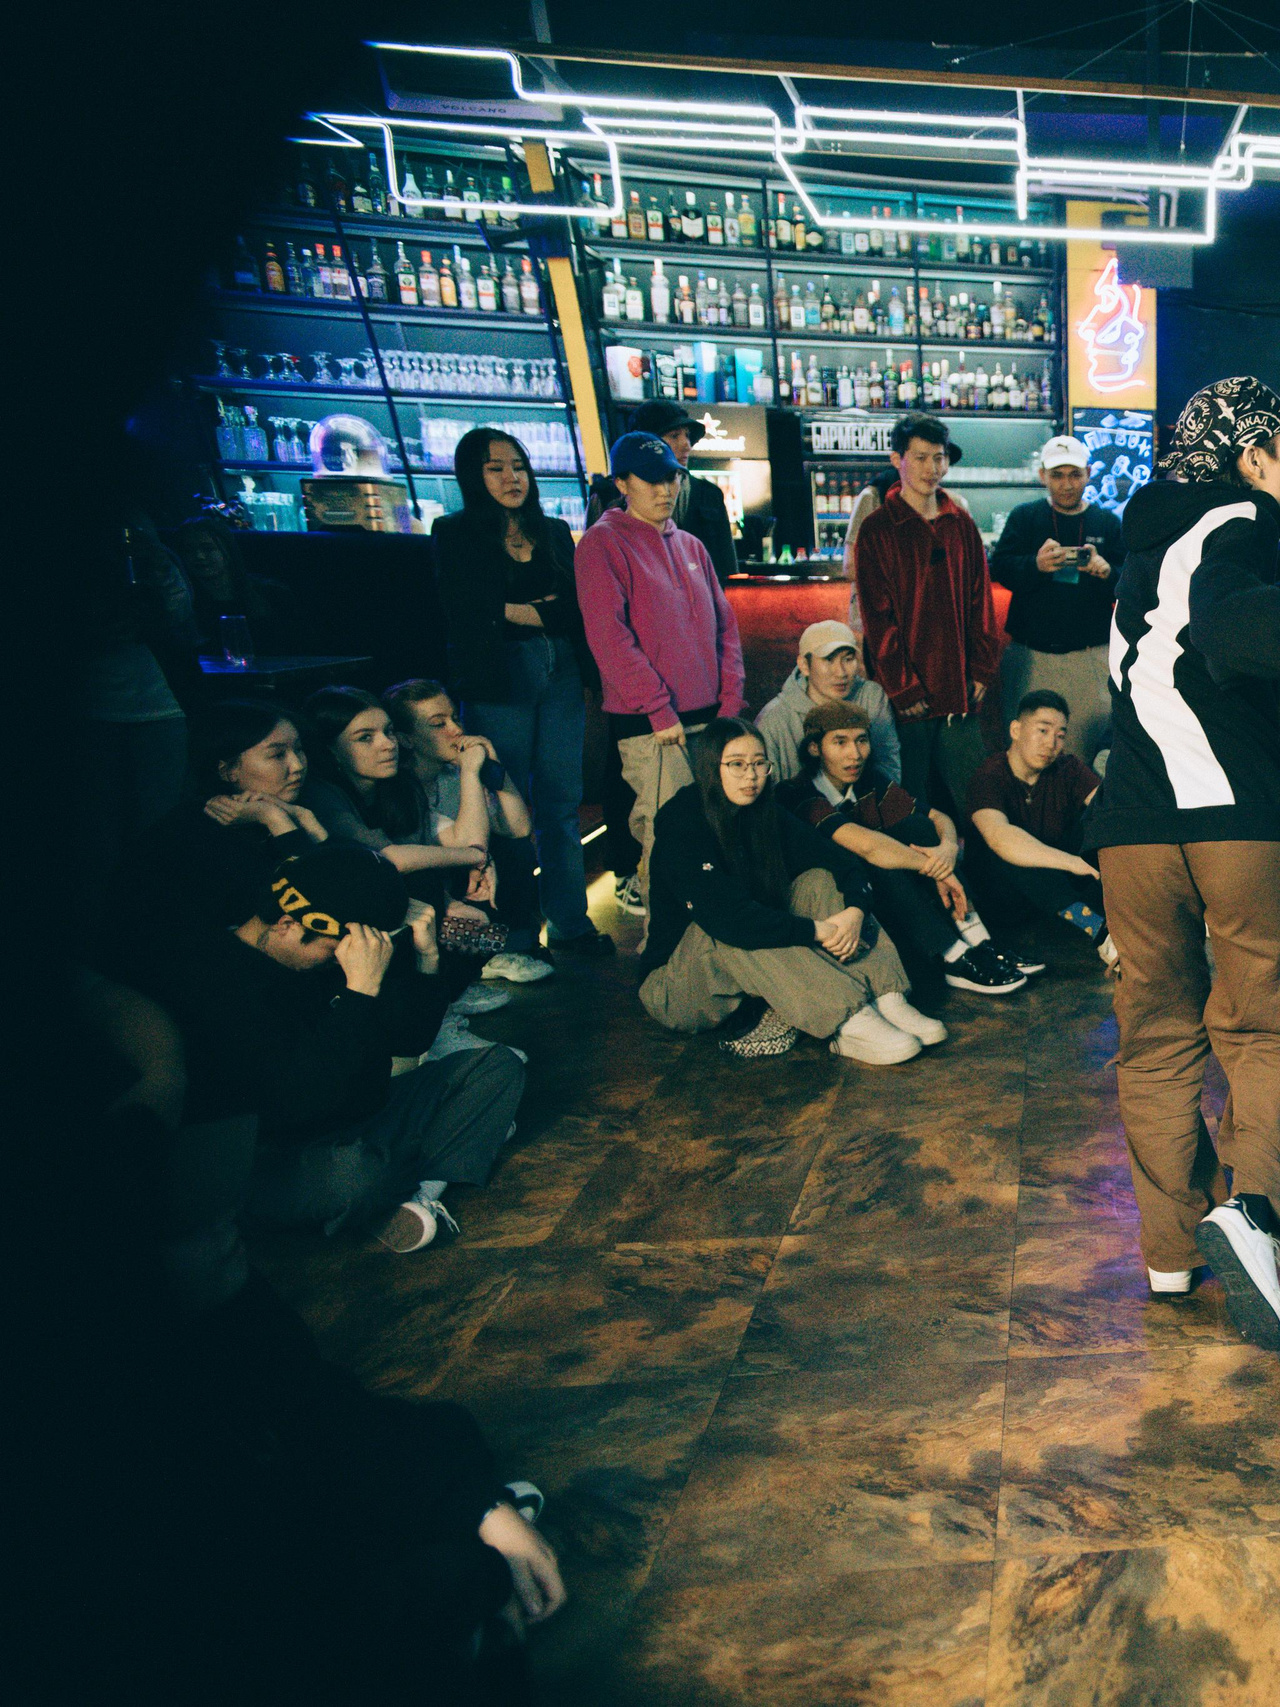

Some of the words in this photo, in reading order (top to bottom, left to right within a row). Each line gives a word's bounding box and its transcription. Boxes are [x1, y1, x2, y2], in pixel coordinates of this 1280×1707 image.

[441, 104, 507, 114] VOLCANO
[812, 424, 892, 451] БАРМЕЙСТЕ
[1232, 415, 1269, 440] АЙКАЛ
